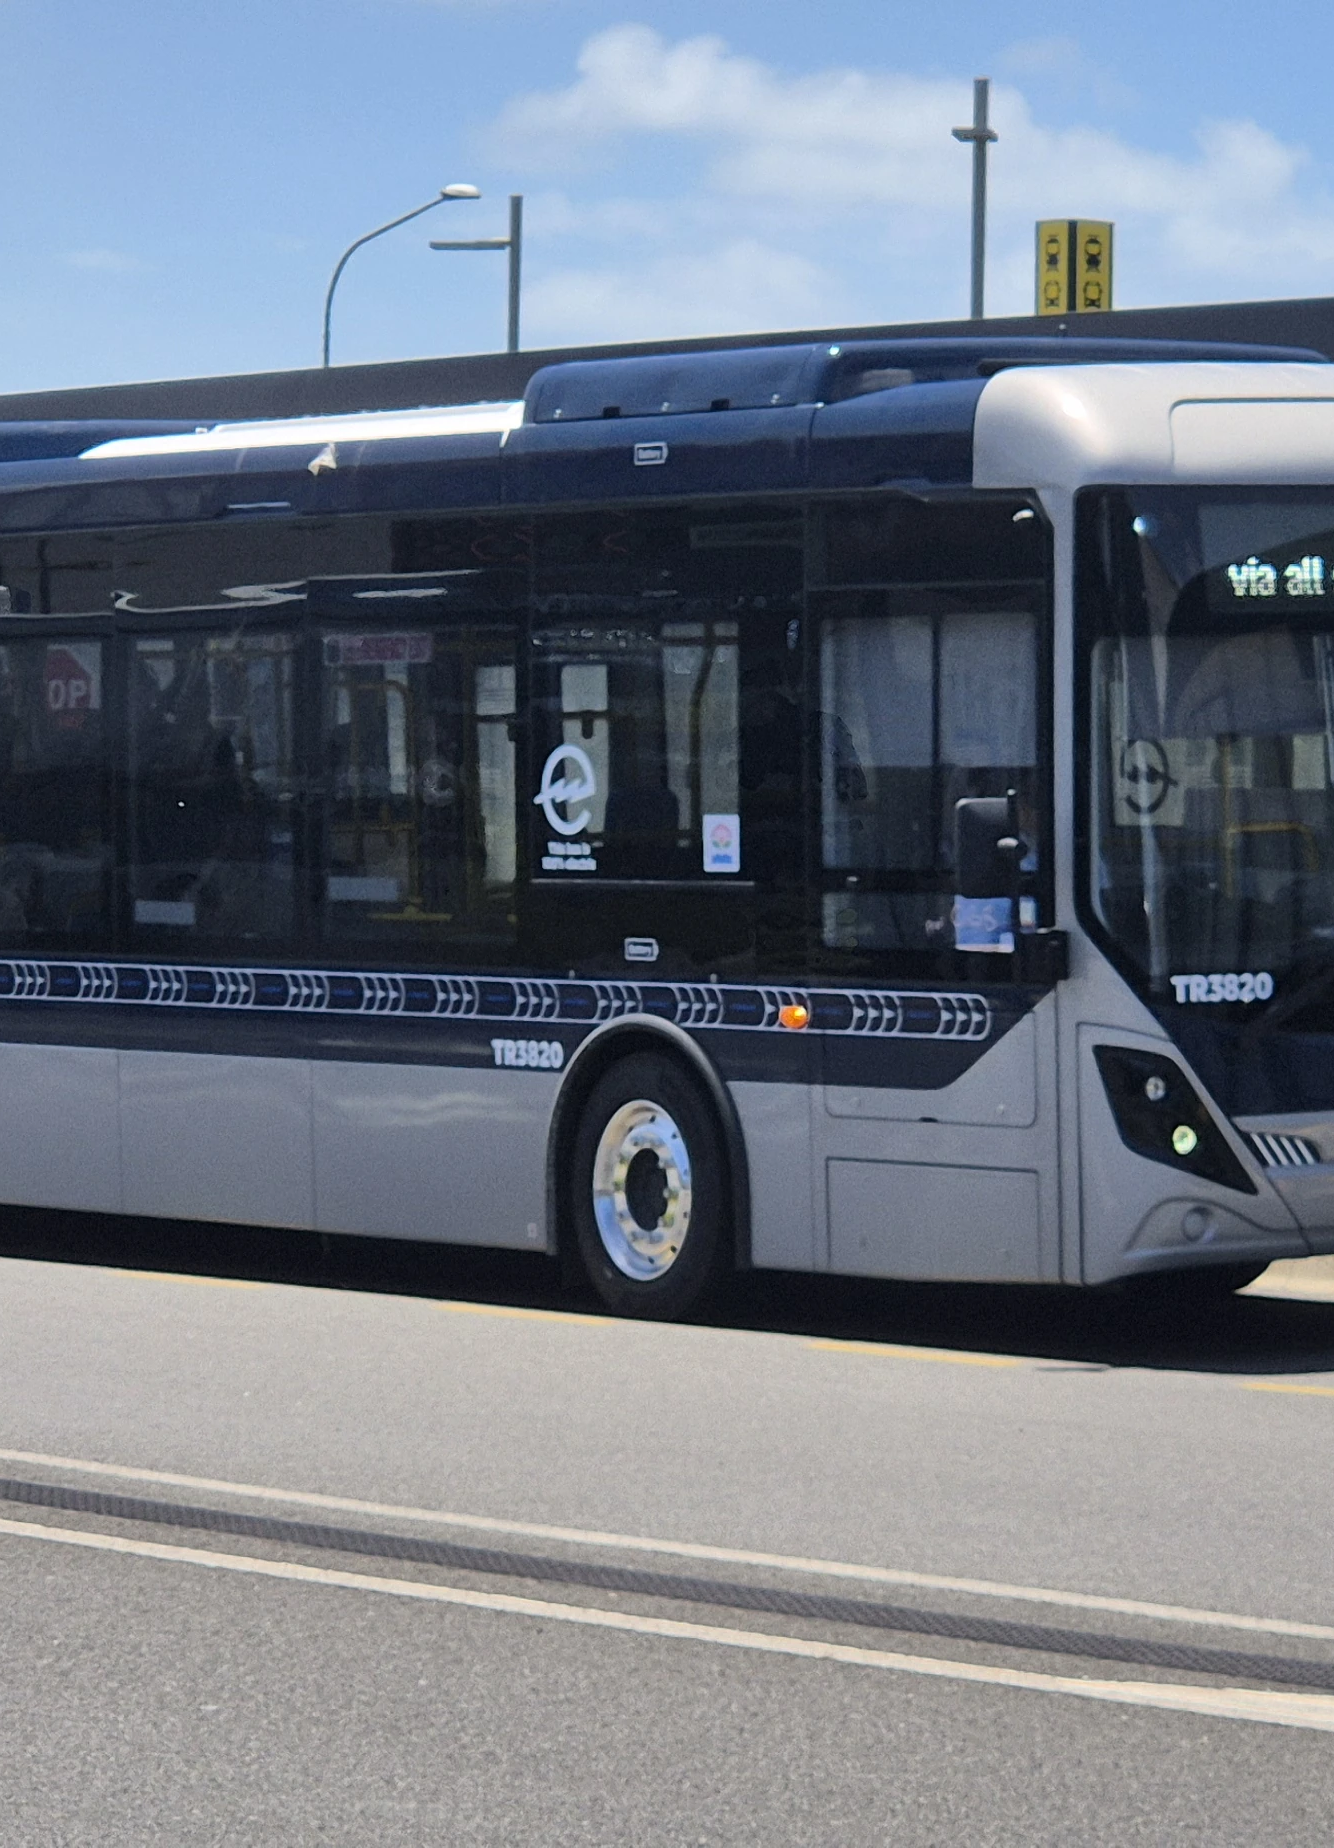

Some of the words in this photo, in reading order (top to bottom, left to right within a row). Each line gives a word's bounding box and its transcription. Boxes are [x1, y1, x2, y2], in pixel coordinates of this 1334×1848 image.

[1227, 555, 1278, 597] via
[1282, 555, 1326, 597] all
[1169, 971, 1275, 1004] TR3820
[490, 1037, 564, 1069] TR3820
